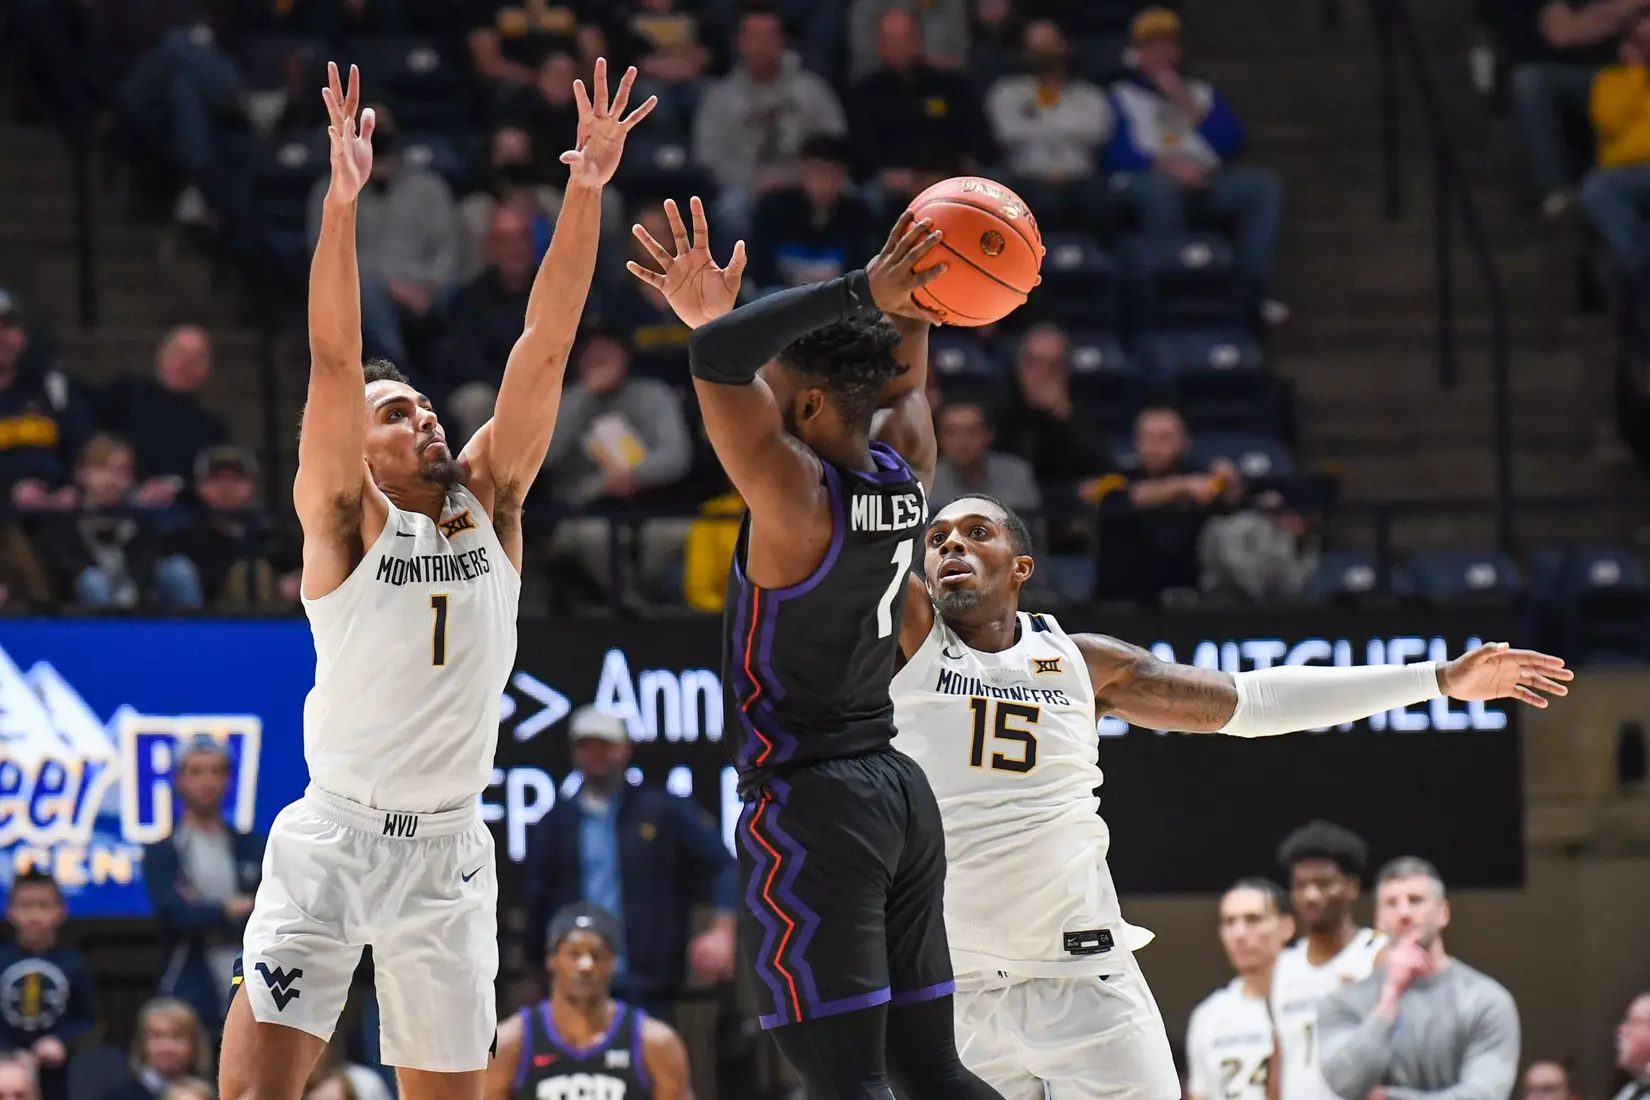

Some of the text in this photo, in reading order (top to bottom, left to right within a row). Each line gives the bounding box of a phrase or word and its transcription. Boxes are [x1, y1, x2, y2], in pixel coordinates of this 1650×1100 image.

[375, 546, 491, 587] MONTAINERS
[876, 538, 914, 639] 1
[430, 593, 449, 667] 1
[969, 696, 1041, 775] 15
[382, 813, 419, 838] WVU
